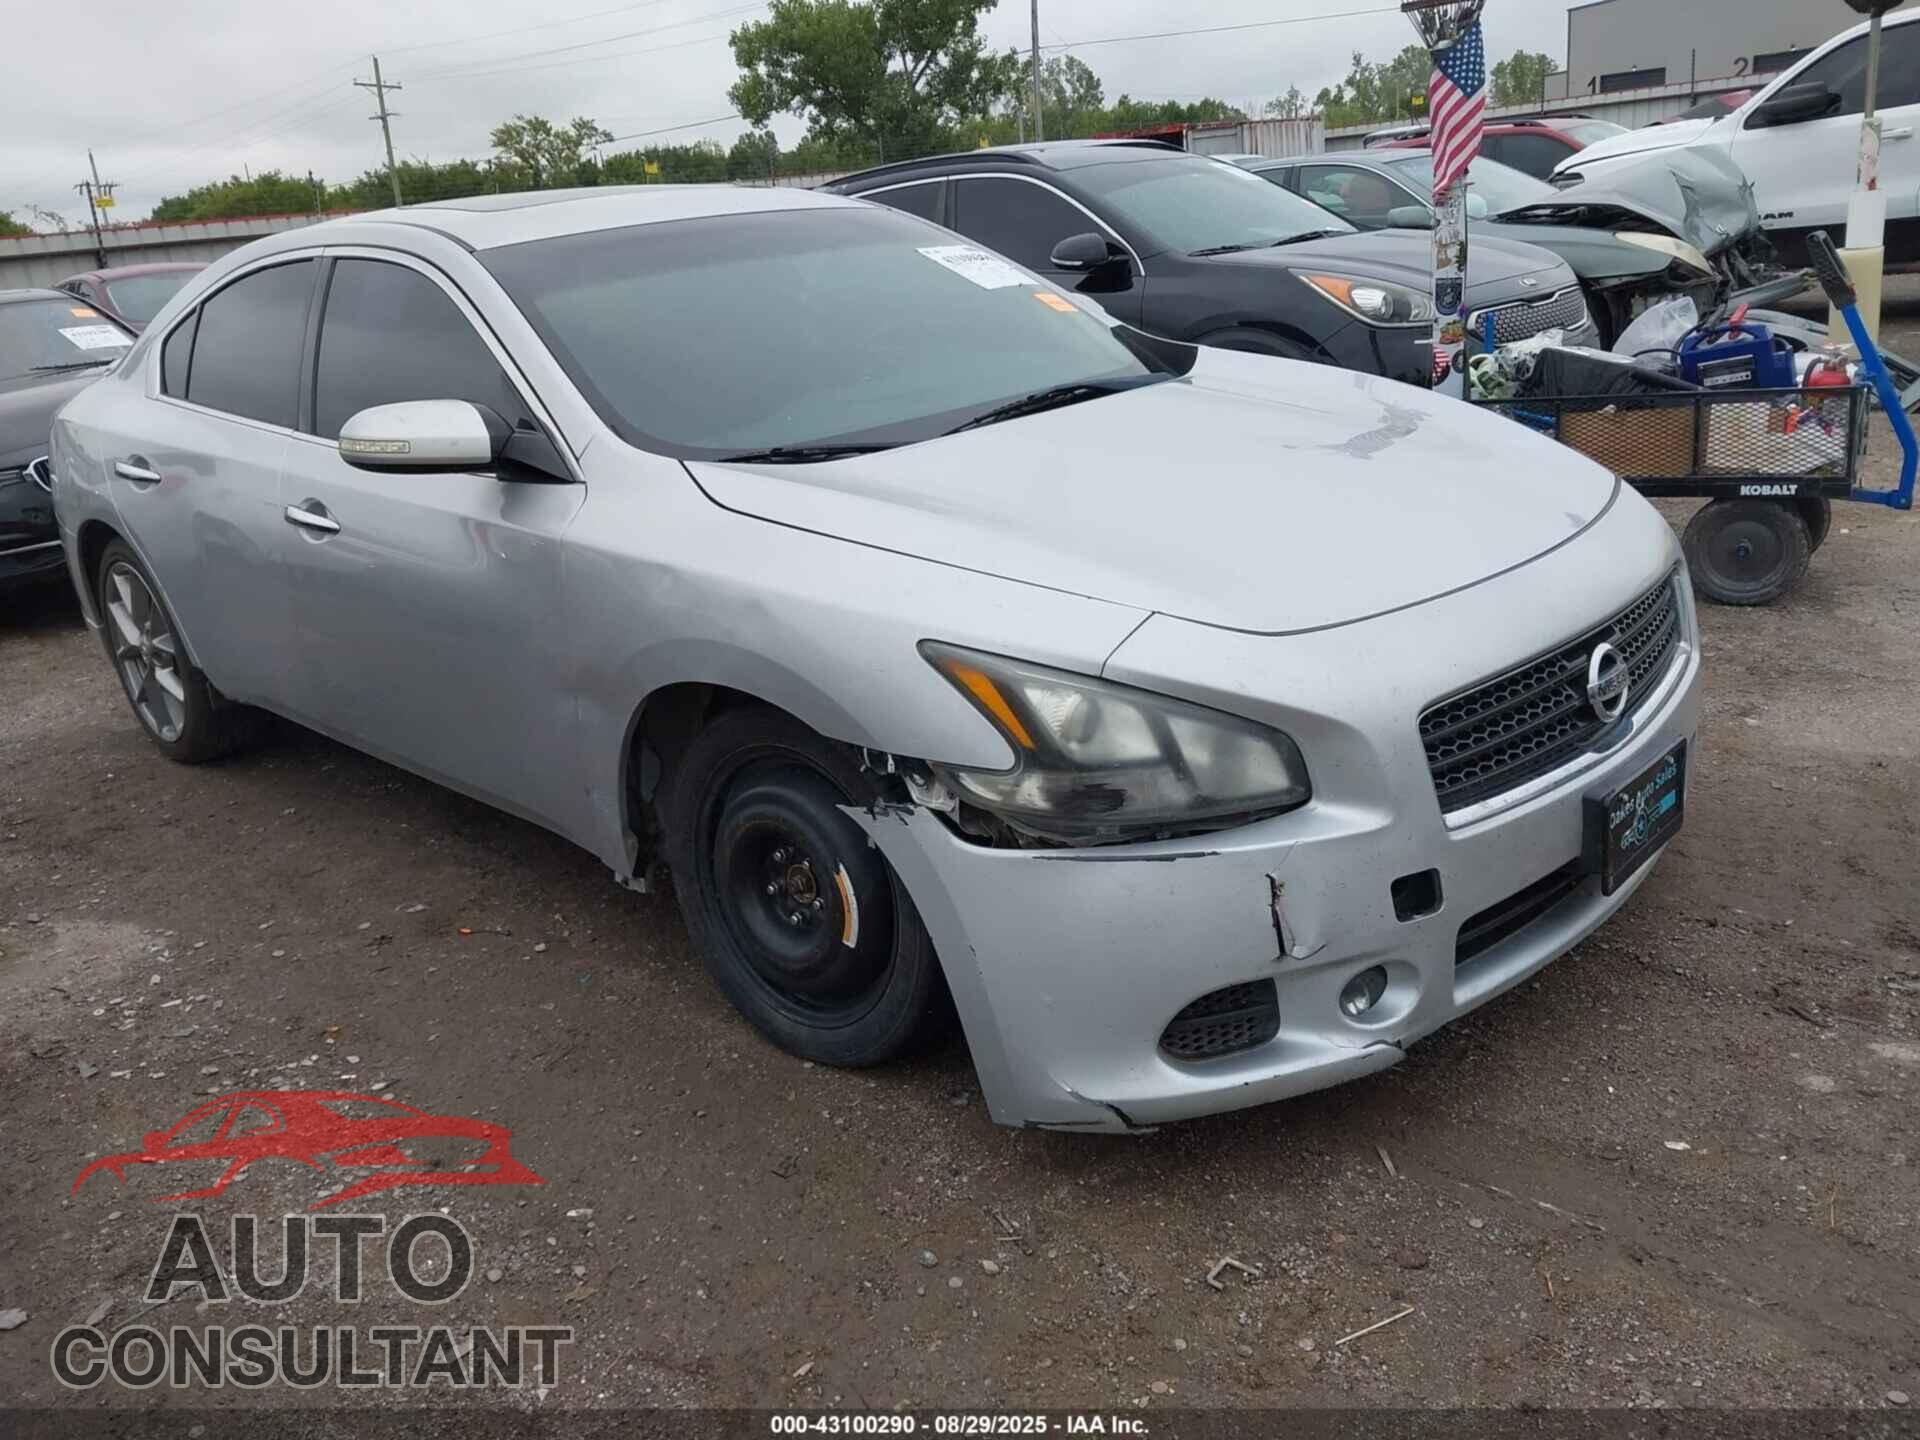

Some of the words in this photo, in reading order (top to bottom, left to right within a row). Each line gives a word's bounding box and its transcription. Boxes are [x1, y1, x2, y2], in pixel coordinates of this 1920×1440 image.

[1733, 56, 1749, 77] 2
[1586, 75, 1597, 95] 1
[1758, 210, 1795, 221] AM
[1740, 484, 1798, 496] KOBALT
